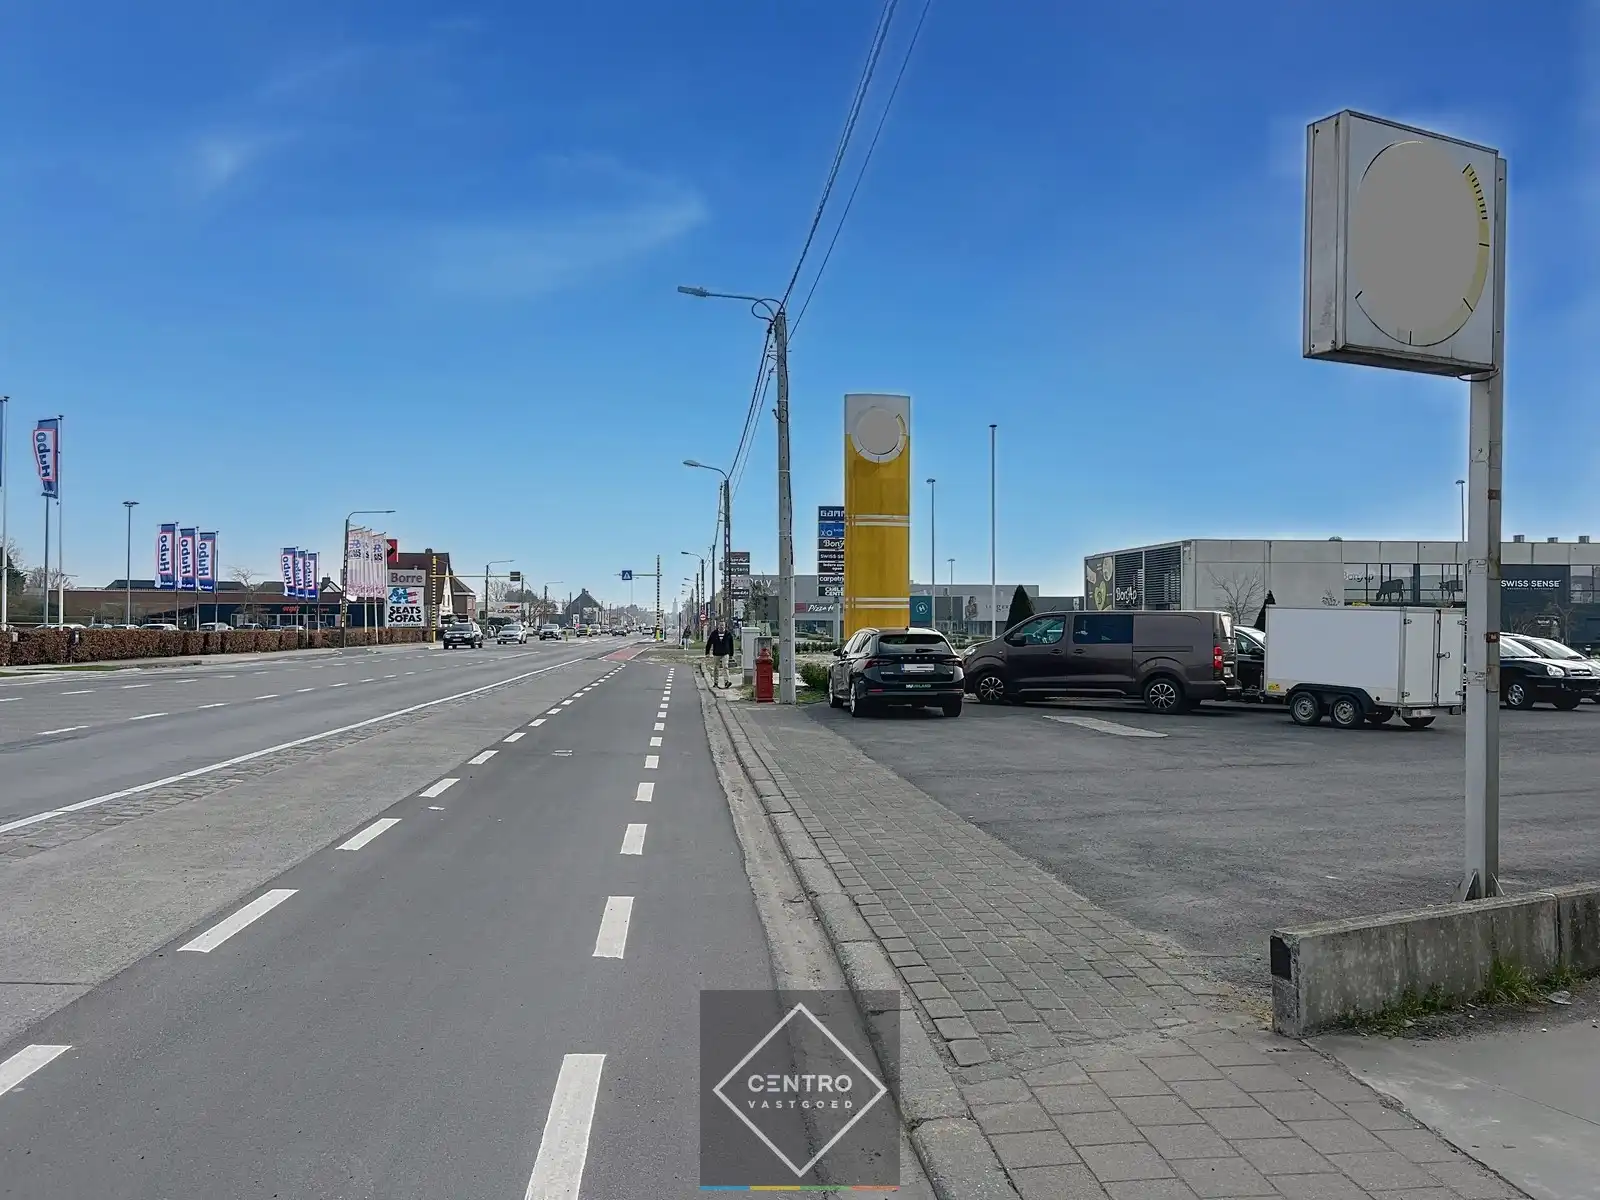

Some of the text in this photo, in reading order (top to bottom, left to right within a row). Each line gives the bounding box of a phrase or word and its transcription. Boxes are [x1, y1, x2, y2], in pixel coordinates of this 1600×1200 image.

[391, 573, 423, 583] Borre
[1500, 579, 1560, 588] SWISS SENSE
[389, 606, 421, 614] SEATS
[388, 614, 422, 623] SOFAS
